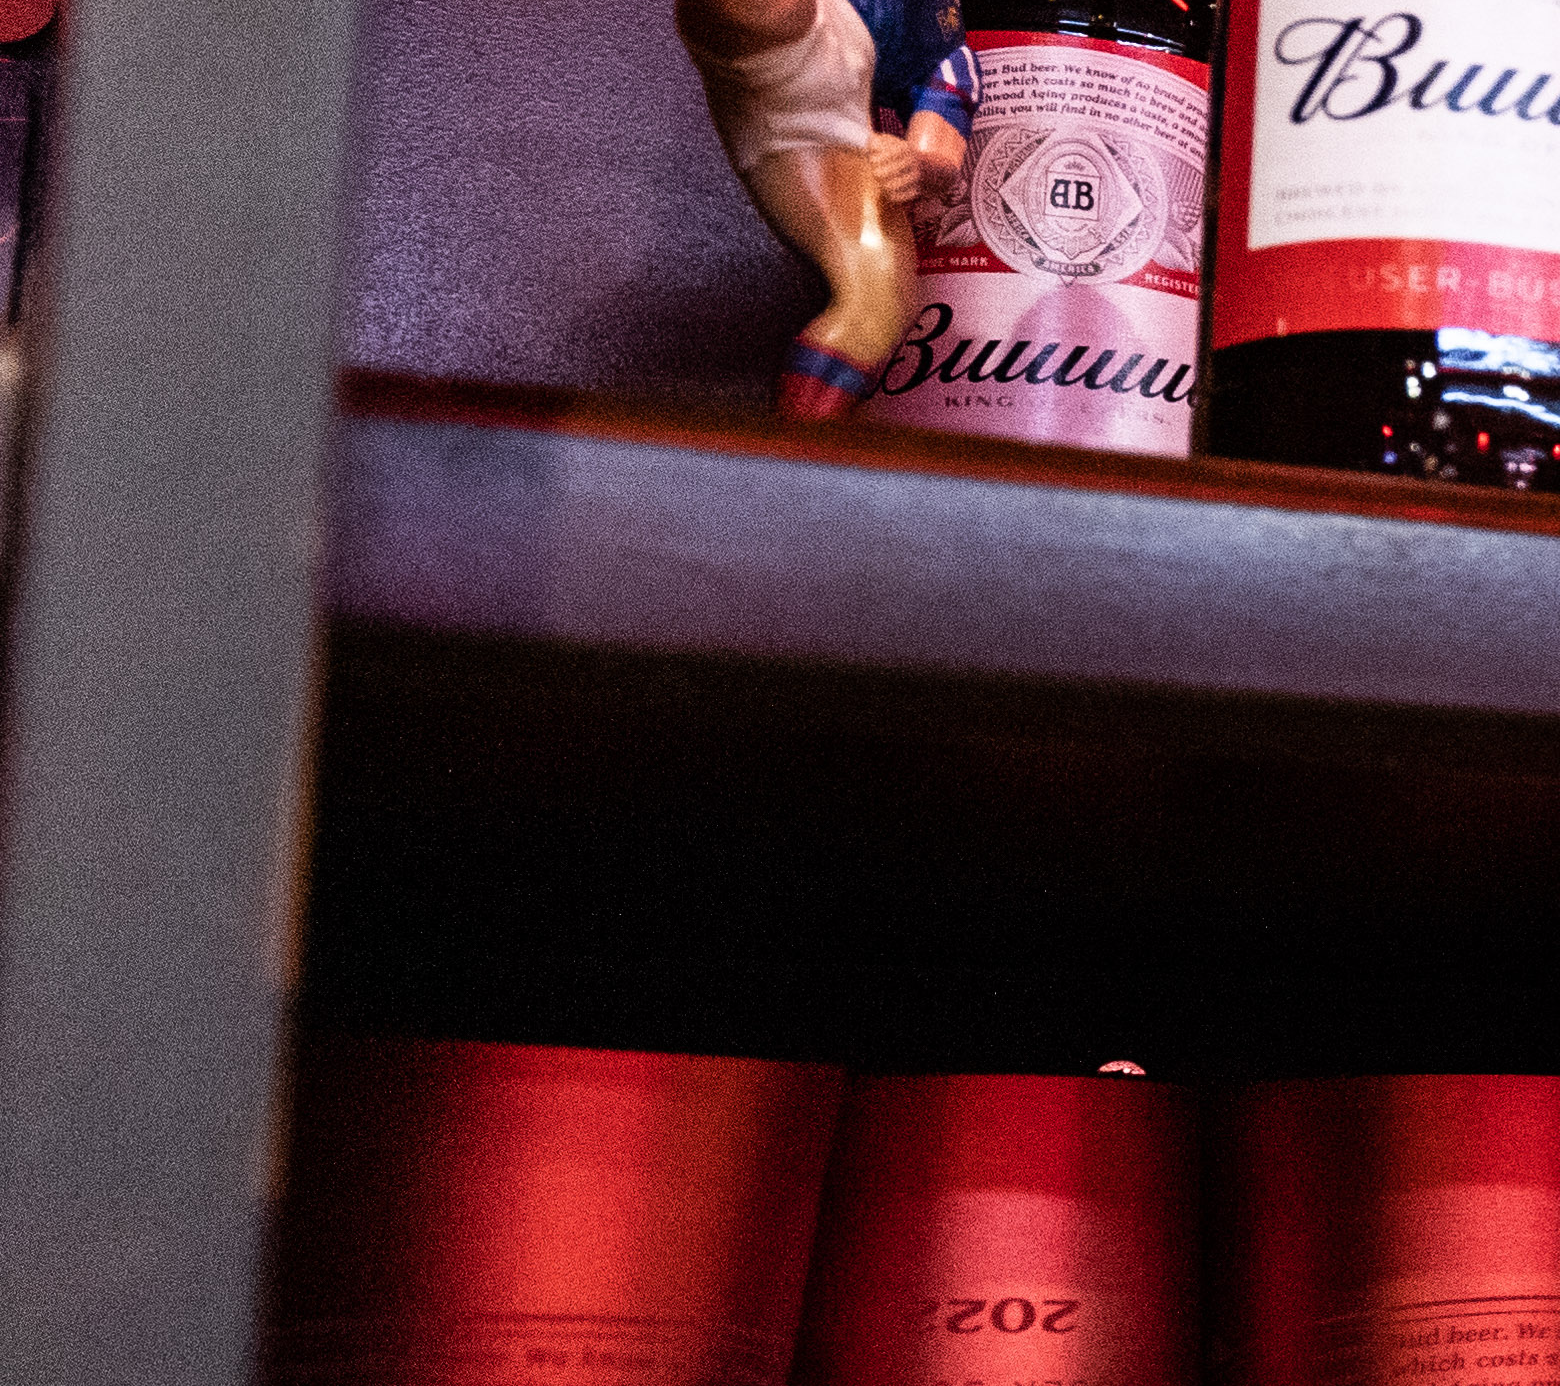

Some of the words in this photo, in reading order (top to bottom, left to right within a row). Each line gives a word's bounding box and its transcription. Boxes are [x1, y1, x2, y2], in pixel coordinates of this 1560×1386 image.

[1002, 64, 1027, 74] Bud
[1064, 64, 1082, 74] We
[1086, 66, 1118, 81] know
[1120, 75, 1136, 84] of
[1003, 77, 1039, 87] which
[1043, 77, 1076, 87] costs
[1081, 79, 1094, 89] so
[1098, 83, 1131, 98] much
[1071, 94, 1127, 110] produces
[1010, 104, 1032, 114] you
[1036, 103, 1058, 113] will
[1061, 104, 1086, 116] find
[1089, 107, 1101, 118] in
[1104, 111, 1120, 122] no
[1122, 115, 1152, 131] other
[949, 257, 988, 267] MARK
[1476, 1351, 1538, 1368] costs
